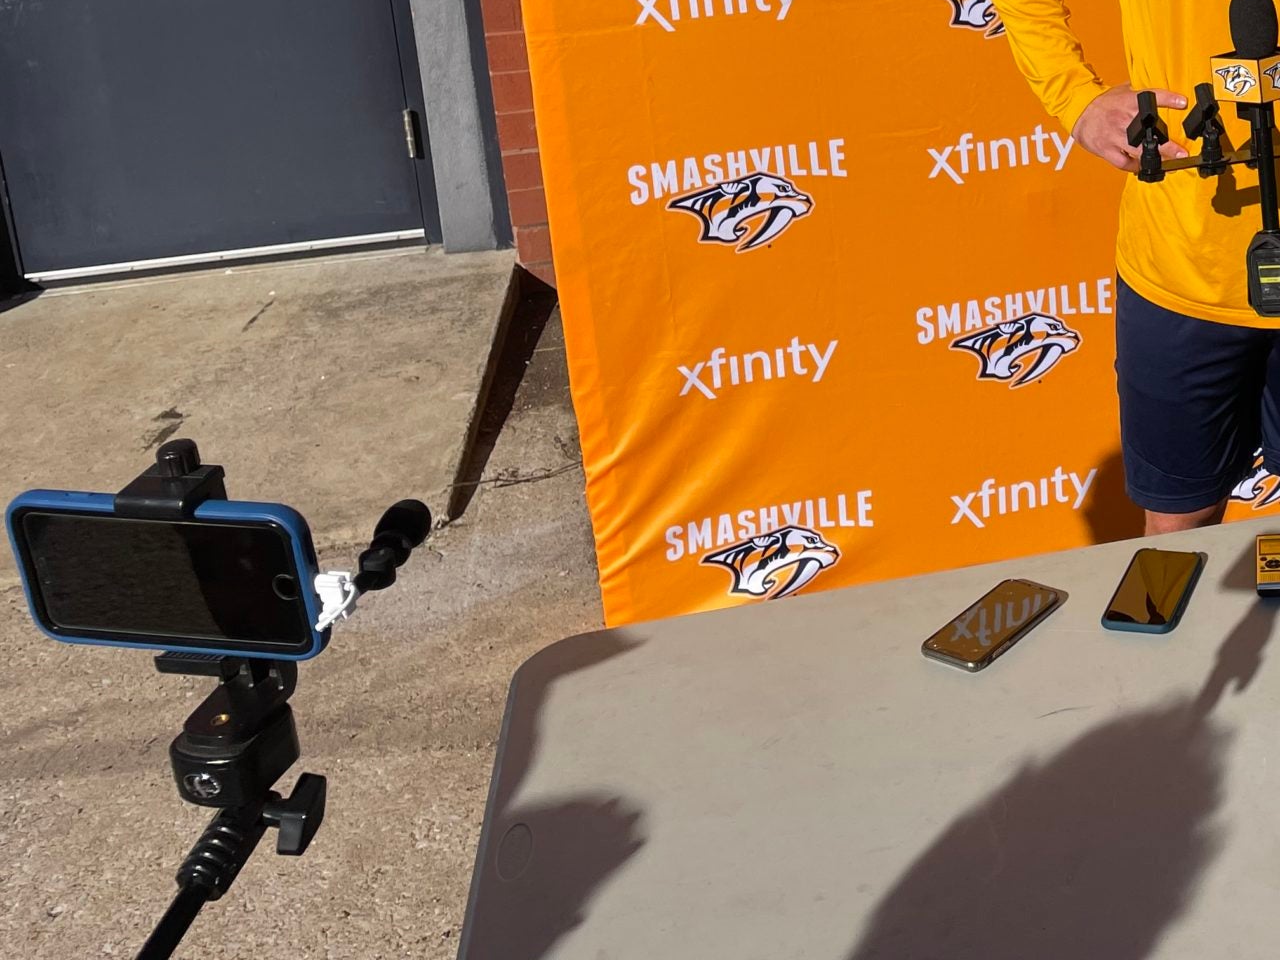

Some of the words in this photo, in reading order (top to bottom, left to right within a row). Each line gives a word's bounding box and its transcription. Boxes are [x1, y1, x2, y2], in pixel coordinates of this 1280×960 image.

[627, 138, 848, 206] SMASHVILLE
[927, 124, 1076, 185] xfinity
[915, 277, 1113, 345] SMASHVILLE
[677, 336, 838, 400] xfinity
[665, 489, 874, 562] SMASHVILLE
[950, 466, 1097, 529] xfinity
